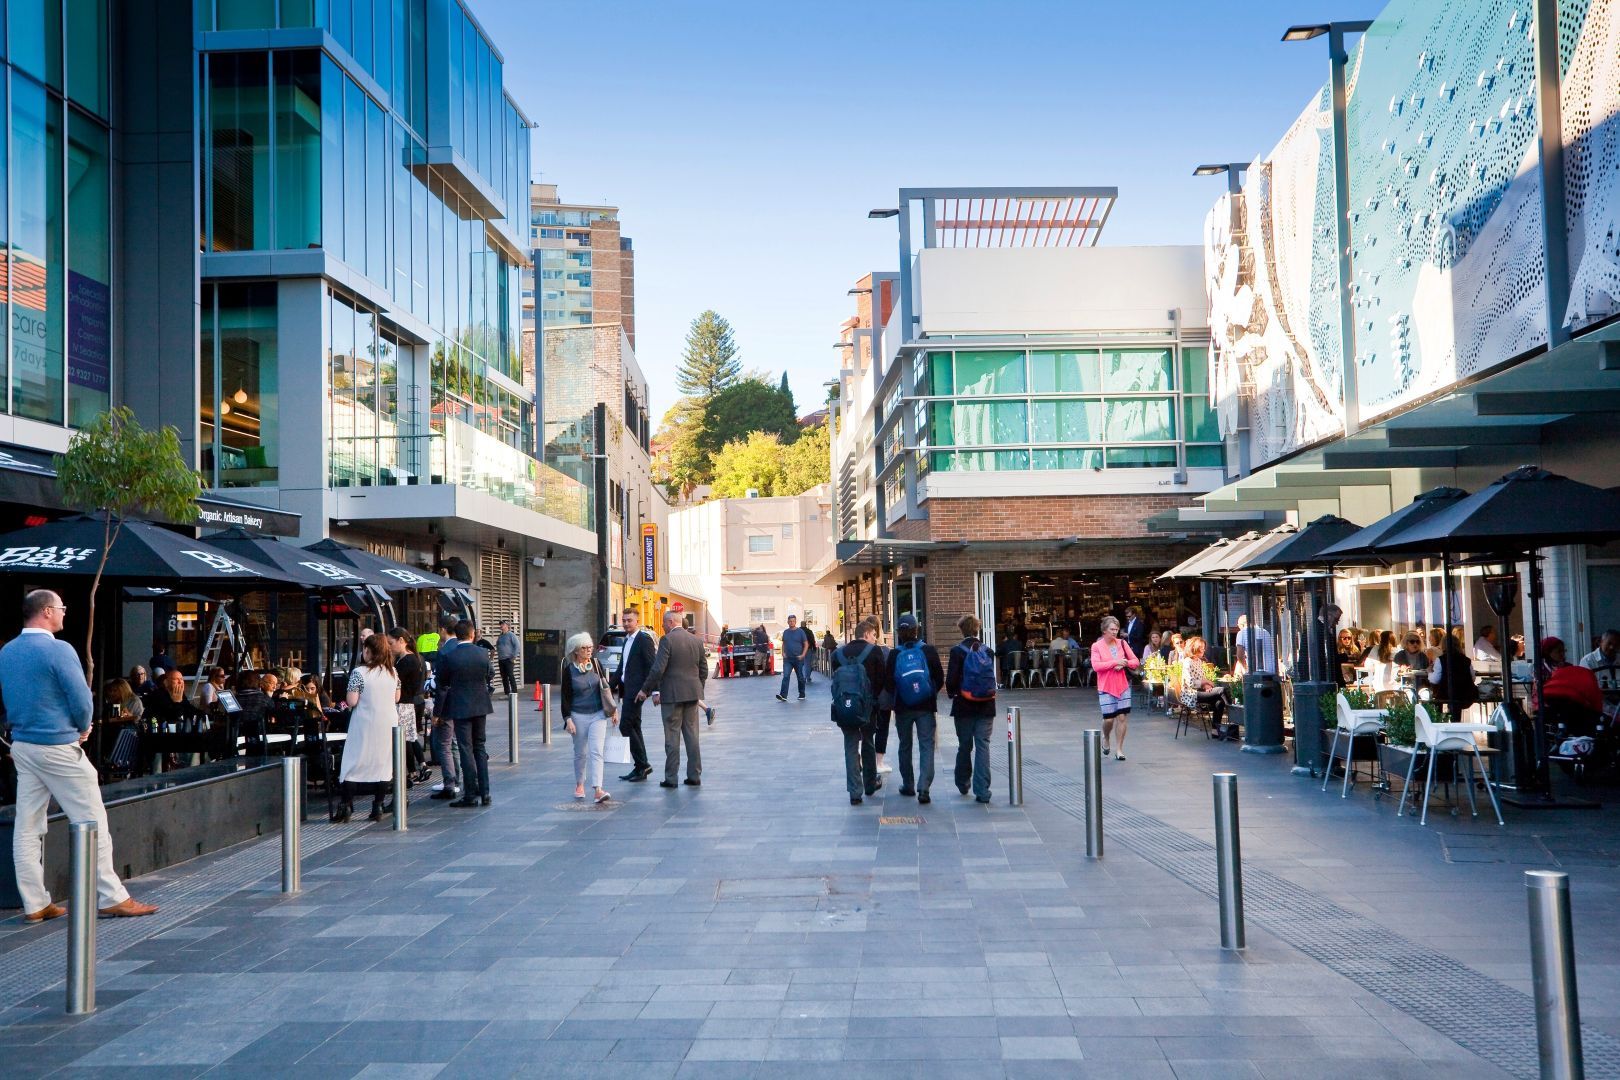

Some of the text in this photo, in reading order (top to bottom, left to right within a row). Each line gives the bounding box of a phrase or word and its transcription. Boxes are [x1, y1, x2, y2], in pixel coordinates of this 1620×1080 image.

[12, 312, 47, 339] care
[199, 508, 263, 528] Organic Artisan Bakery
[646, 556, 654, 580] DISCOUNT
